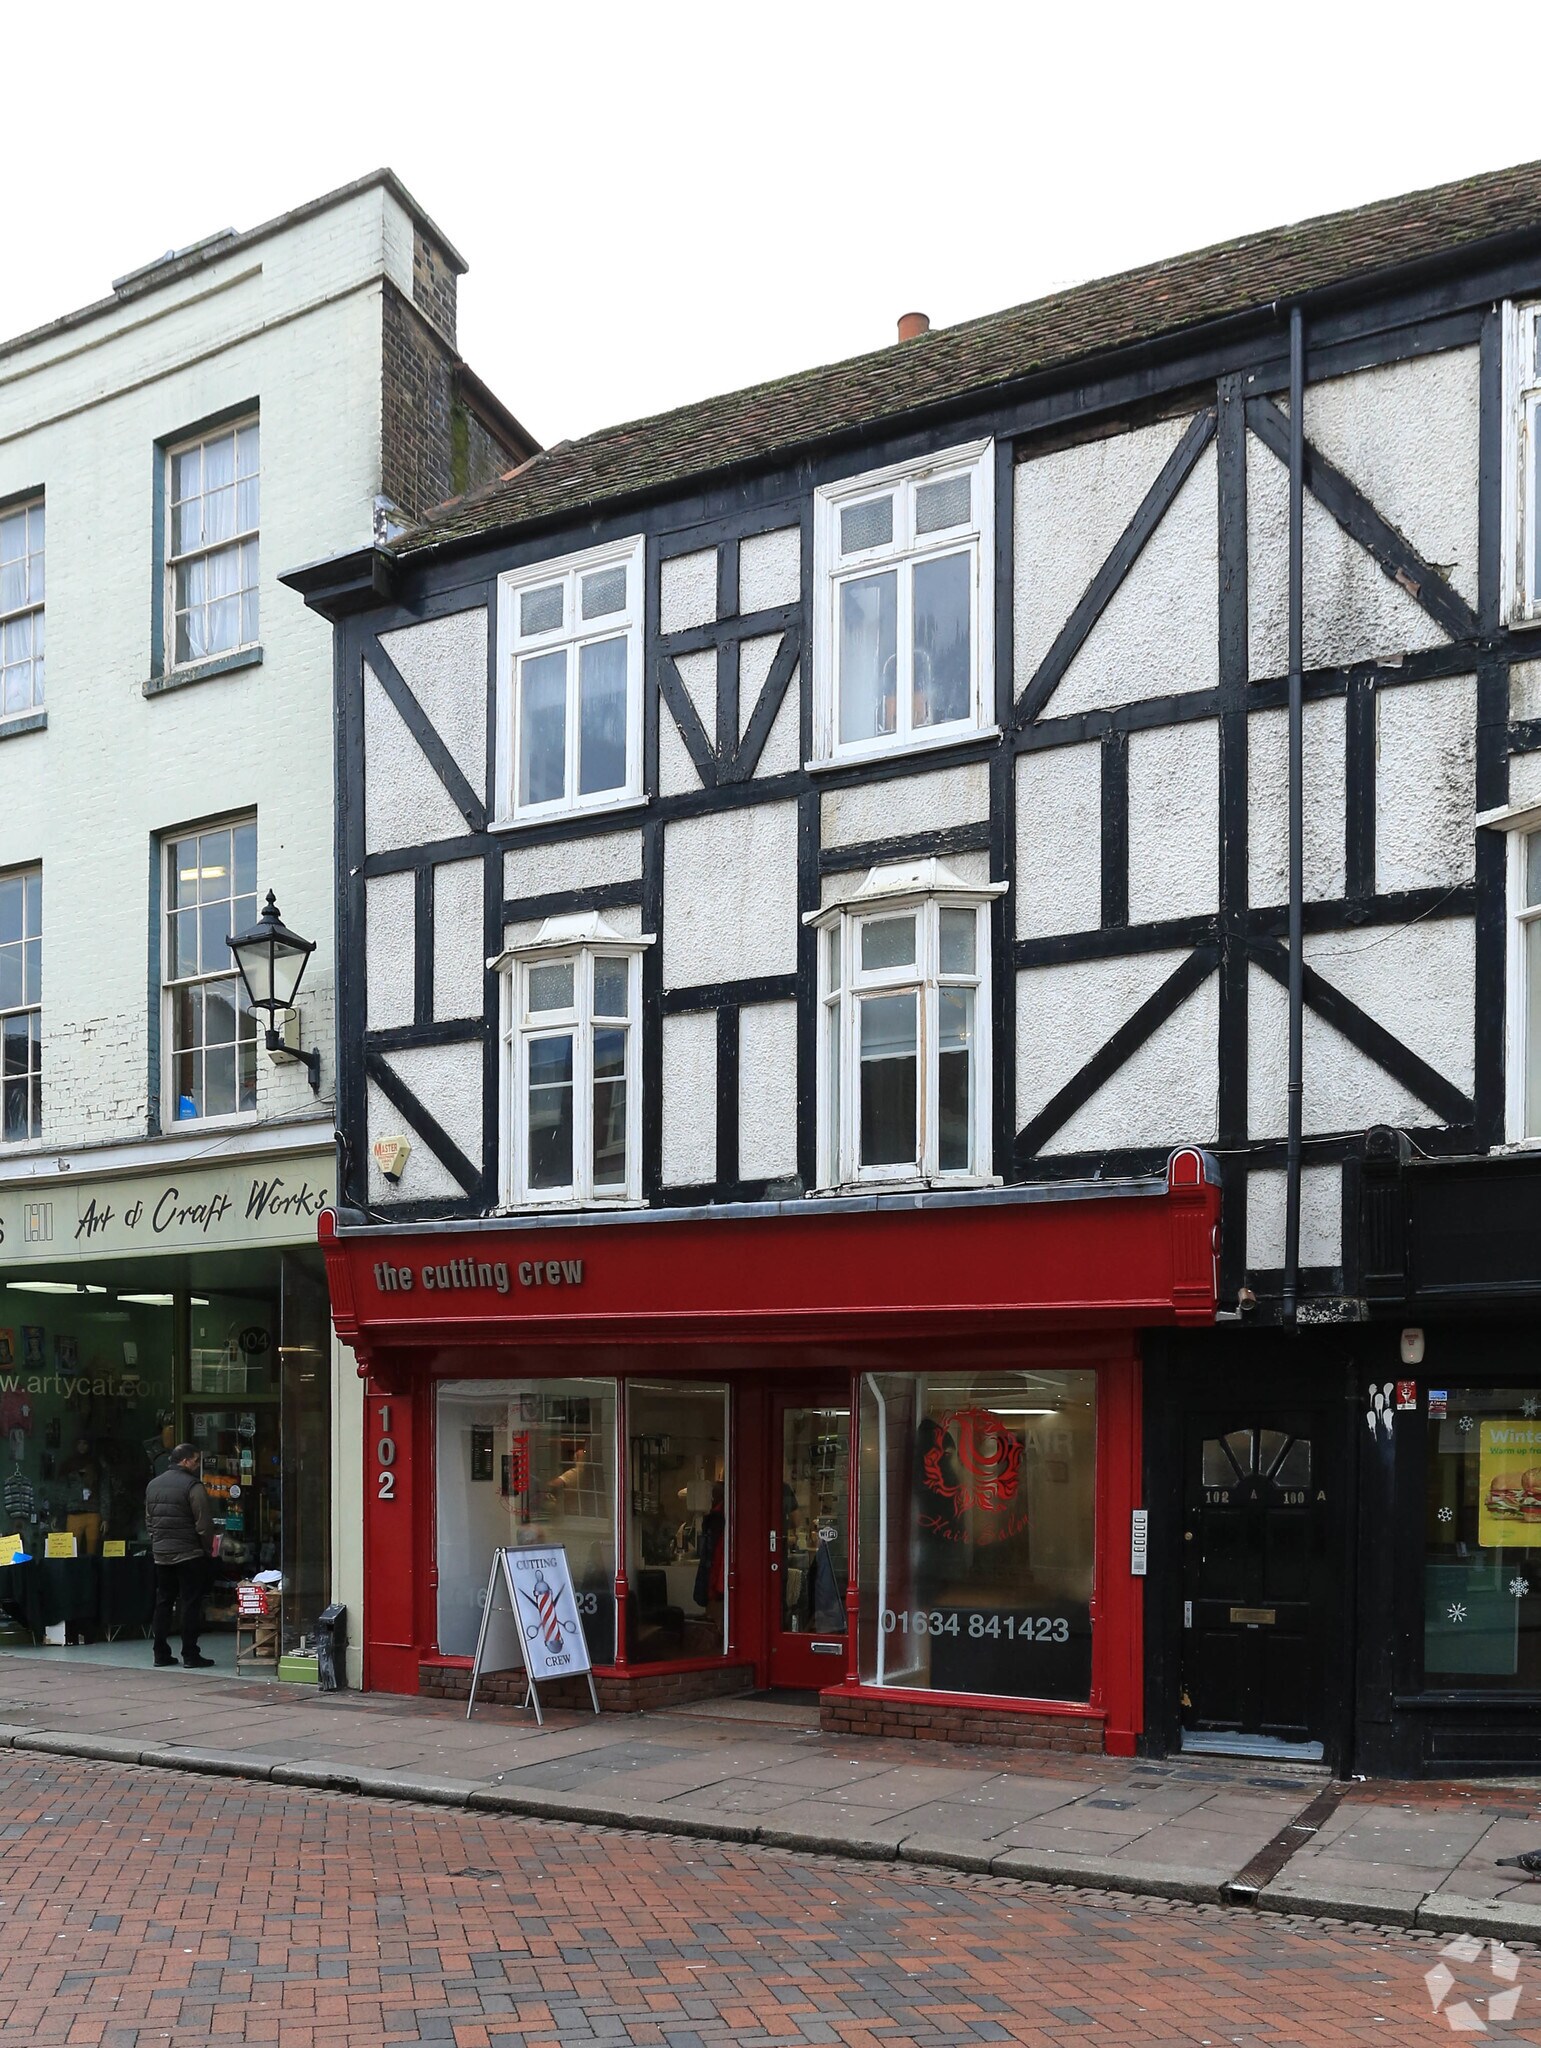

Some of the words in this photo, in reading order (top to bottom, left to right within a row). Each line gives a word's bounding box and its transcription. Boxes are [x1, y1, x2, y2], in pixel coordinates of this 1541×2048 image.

[374, 1143, 398, 1156] MASTER
[74, 1199, 115, 1239] Art
[152, 1187, 233, 1233] Craft
[244, 1177, 329, 1220] Works
[373, 1262, 413, 1291] the
[421, 1257, 510, 1293] cutting
[517, 1259, 583, 1286] crew
[241, 1333, 268, 1350] 104
[377, 1405, 396, 1499] 102
[1490, 1447, 1515, 1455] Warm
[1516, 1447, 1527, 1457] up
[1205, 1490, 1230, 1504] 102
[1317, 1489, 1326, 1501] A
[516, 1557, 558, 1571] CUTTING
[881, 1609, 961, 1637] 01634
[967, 1613, 1070, 1643] 841423
[545, 1654, 572, 1667] CREW
